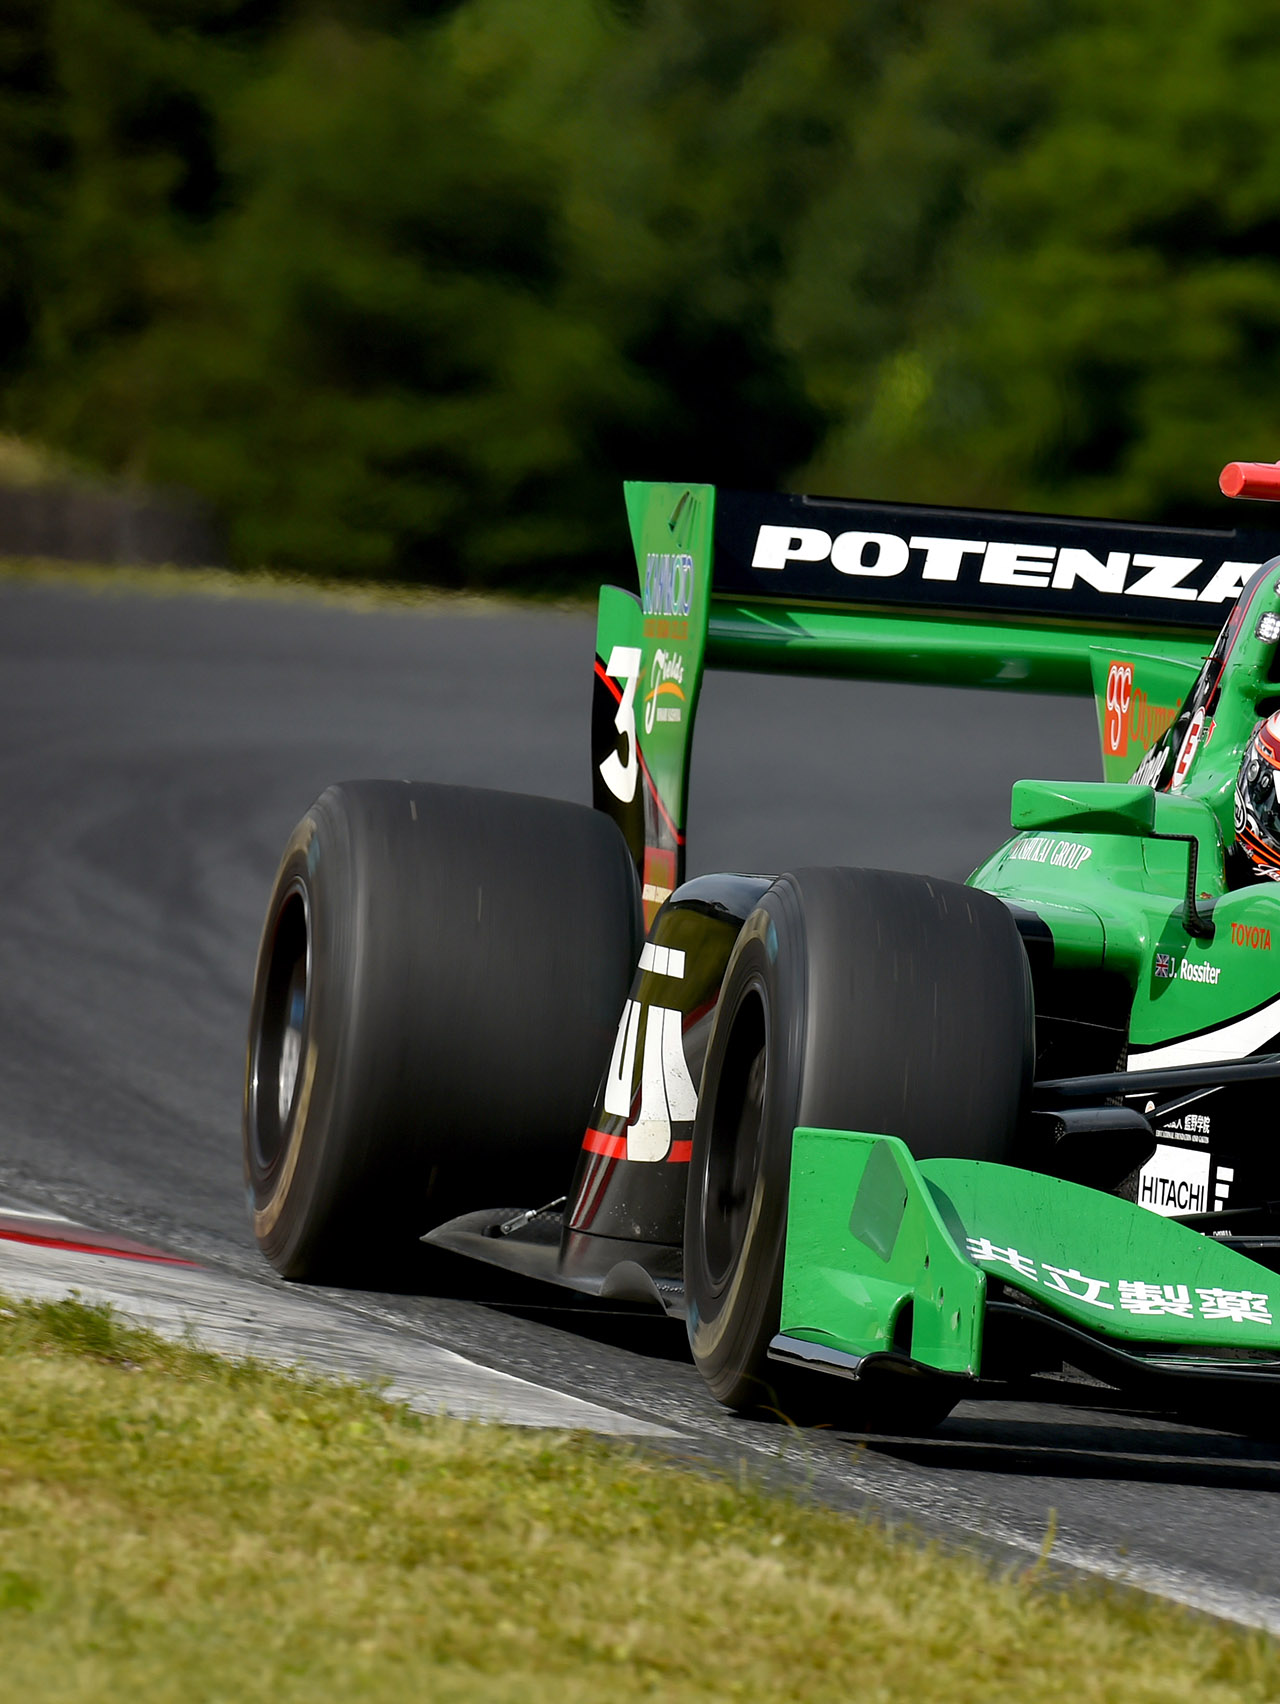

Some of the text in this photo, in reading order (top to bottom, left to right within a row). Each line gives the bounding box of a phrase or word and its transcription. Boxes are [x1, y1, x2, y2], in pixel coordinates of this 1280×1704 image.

[600, 646, 642, 803] 3
[1049, 841, 1093, 870] GROUP
[1231, 922, 1271, 951] TOYOTA
[1180, 958, 1221, 985] Rossiter
[1141, 1175, 1205, 1213] HITACHI
[966, 1237, 1273, 1325] 共立製薬
